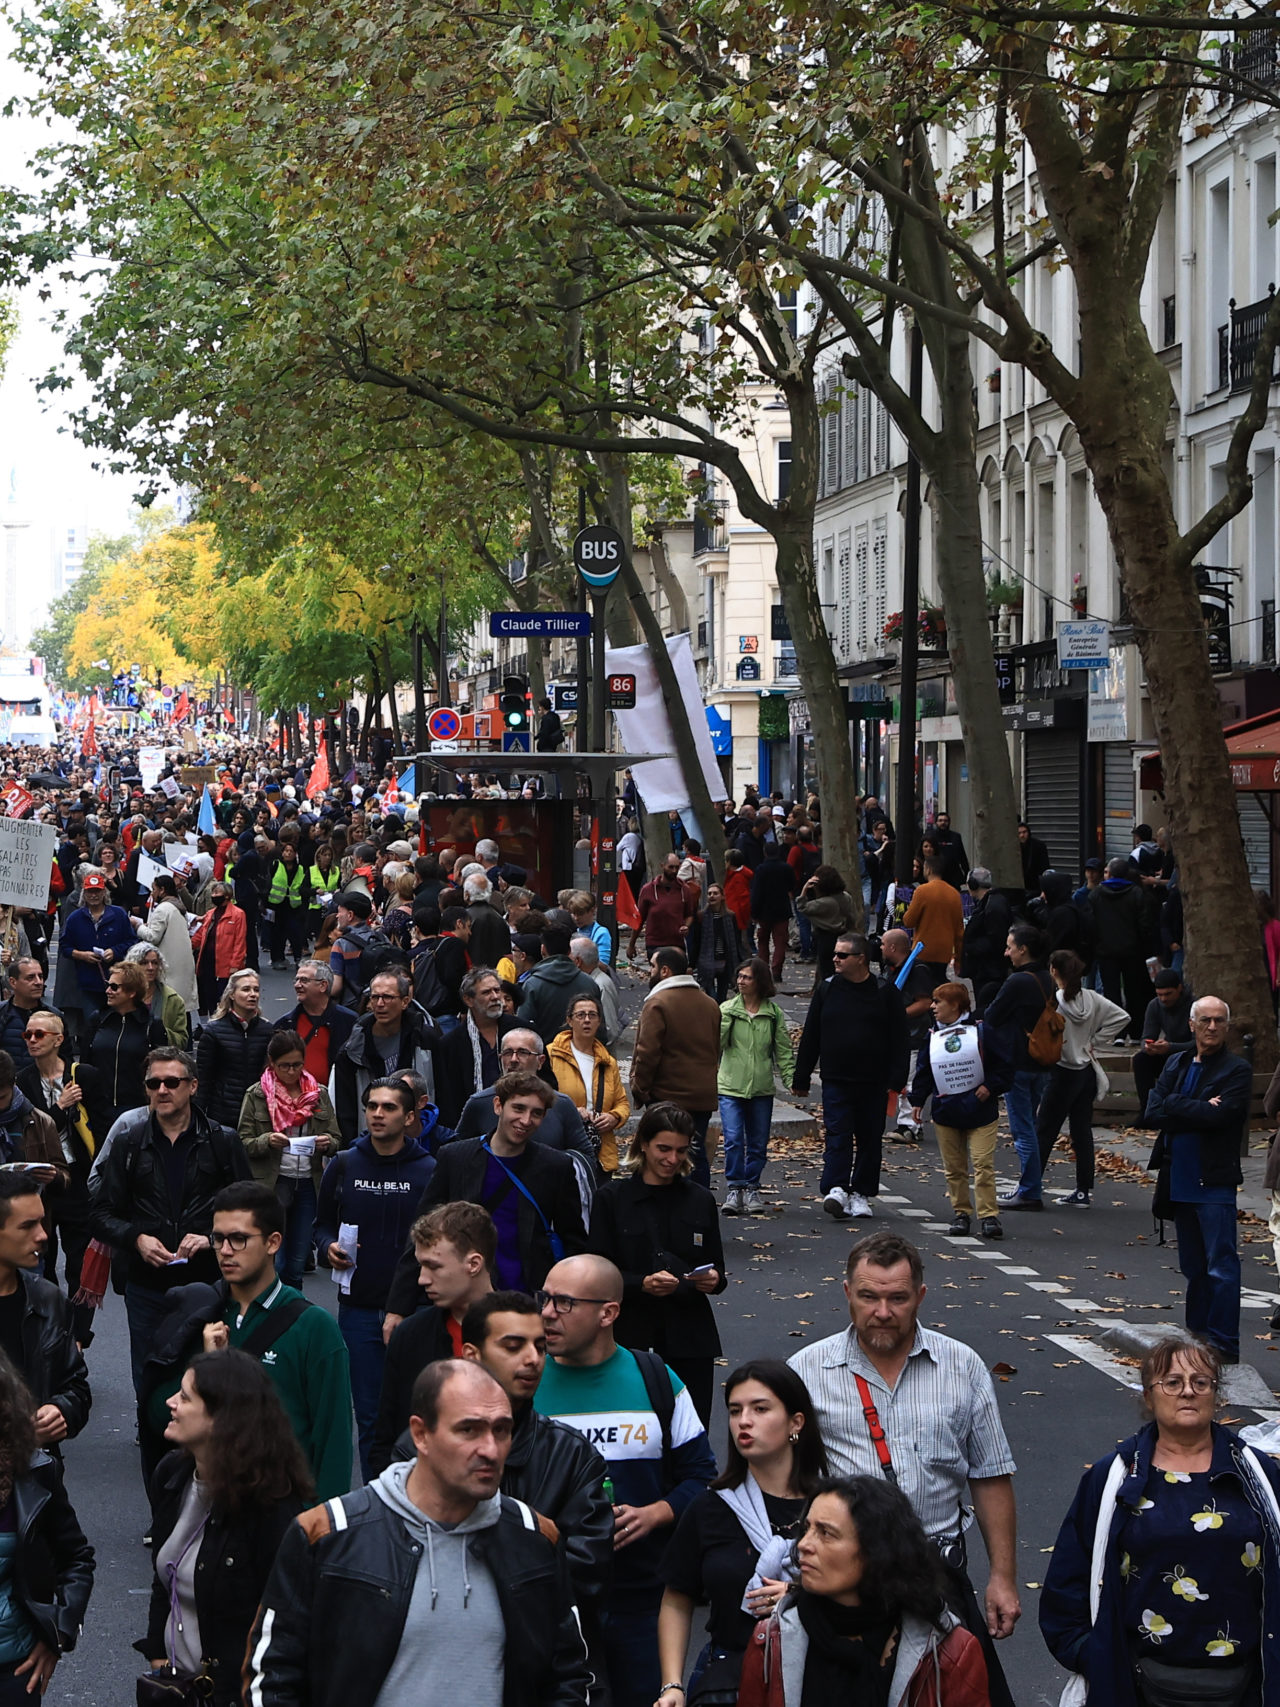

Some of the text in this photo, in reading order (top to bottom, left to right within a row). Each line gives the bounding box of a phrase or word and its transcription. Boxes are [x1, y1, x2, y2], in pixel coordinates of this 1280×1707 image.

[581, 541, 618, 560] BUS
[500, 619, 580, 631] Claude Tillier
[612, 679, 631, 691] 86
[16, 837, 29, 851] LES
[0, 865, 34, 880] PAS LES
